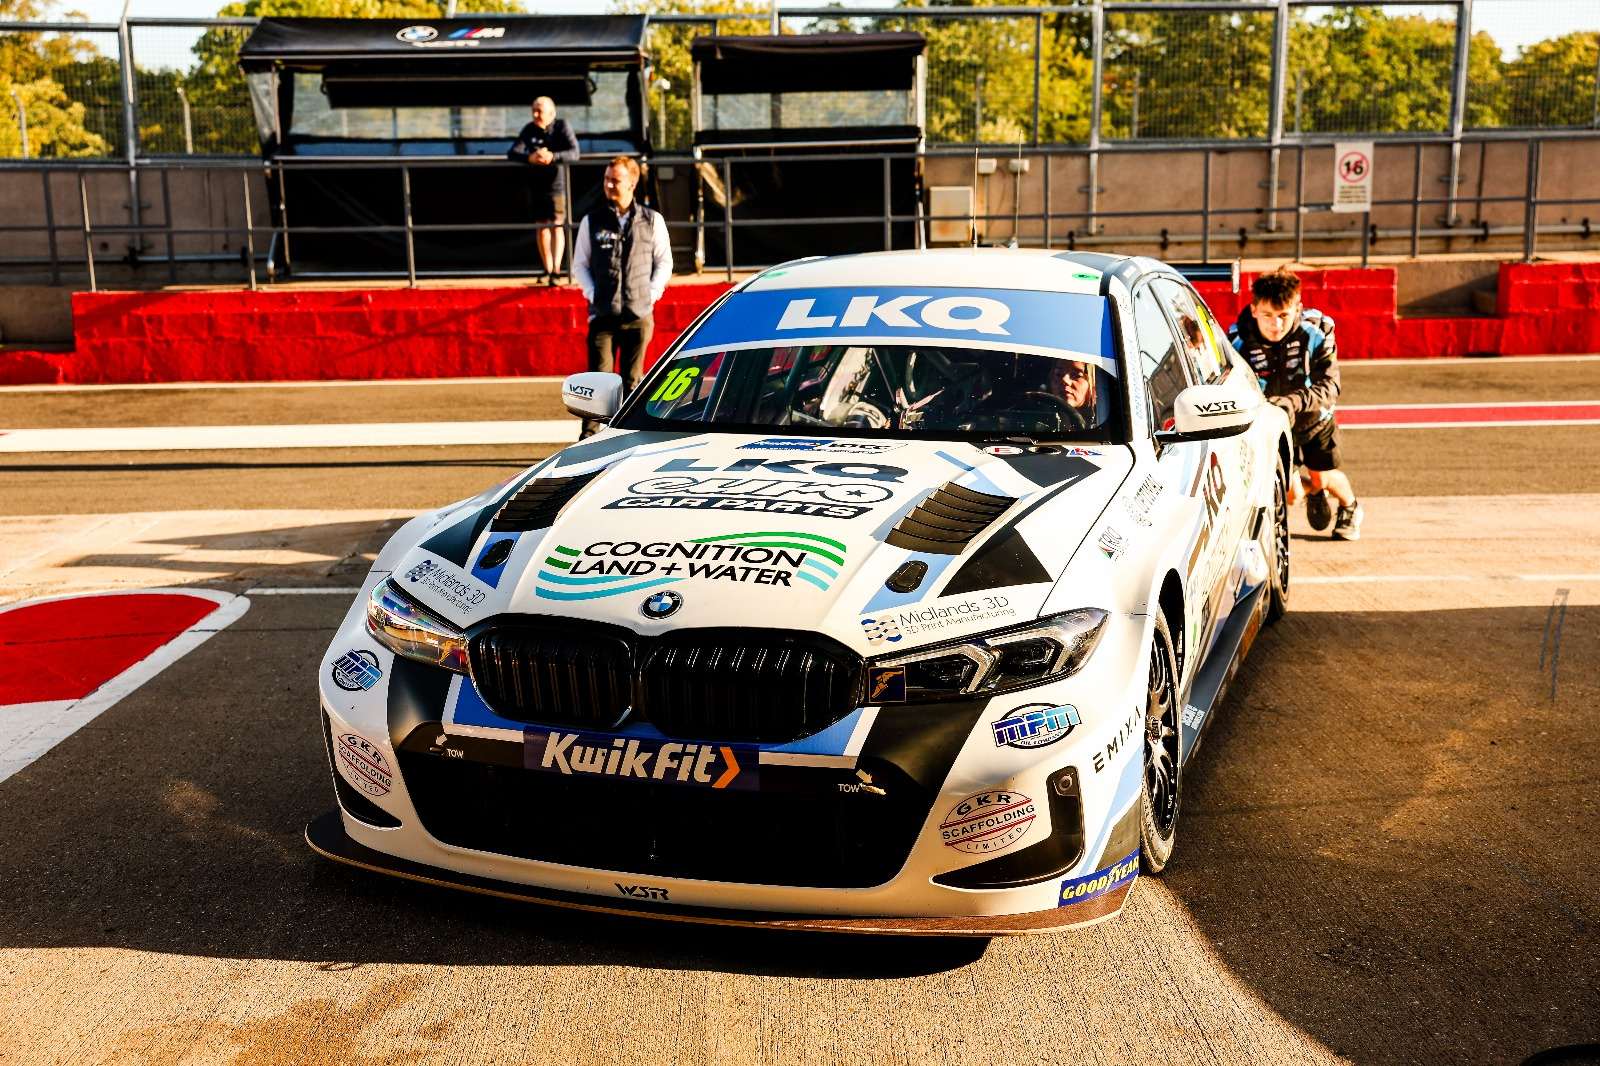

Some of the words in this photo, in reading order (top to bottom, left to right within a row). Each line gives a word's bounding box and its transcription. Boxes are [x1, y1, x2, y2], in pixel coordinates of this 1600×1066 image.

[1344, 160, 1364, 175] 16
[775, 295, 1012, 336] LKQ
[650, 366, 700, 402] 16
[653, 458, 909, 484] LKQ
[617, 497, 703, 508] CAR
[712, 499, 858, 518] PARTS
[583, 541, 807, 568] COGNITION
[569, 559, 656, 575] LAND
[687, 562, 793, 588] WATER
[466, 589, 486, 605] 3D
[900, 600, 981, 627] Midlands
[983, 596, 1009, 610] 3D
[338, 743, 392, 788] SCAFFOLDING
[447, 748, 464, 759] TOW
[838, 783, 860, 794] TOW
[956, 794, 1012, 816] GKR
[942, 804, 1035, 840] SCAFFOLDING
[966, 826, 1022, 850] LIMITED
[614, 882, 670, 901] WSR
